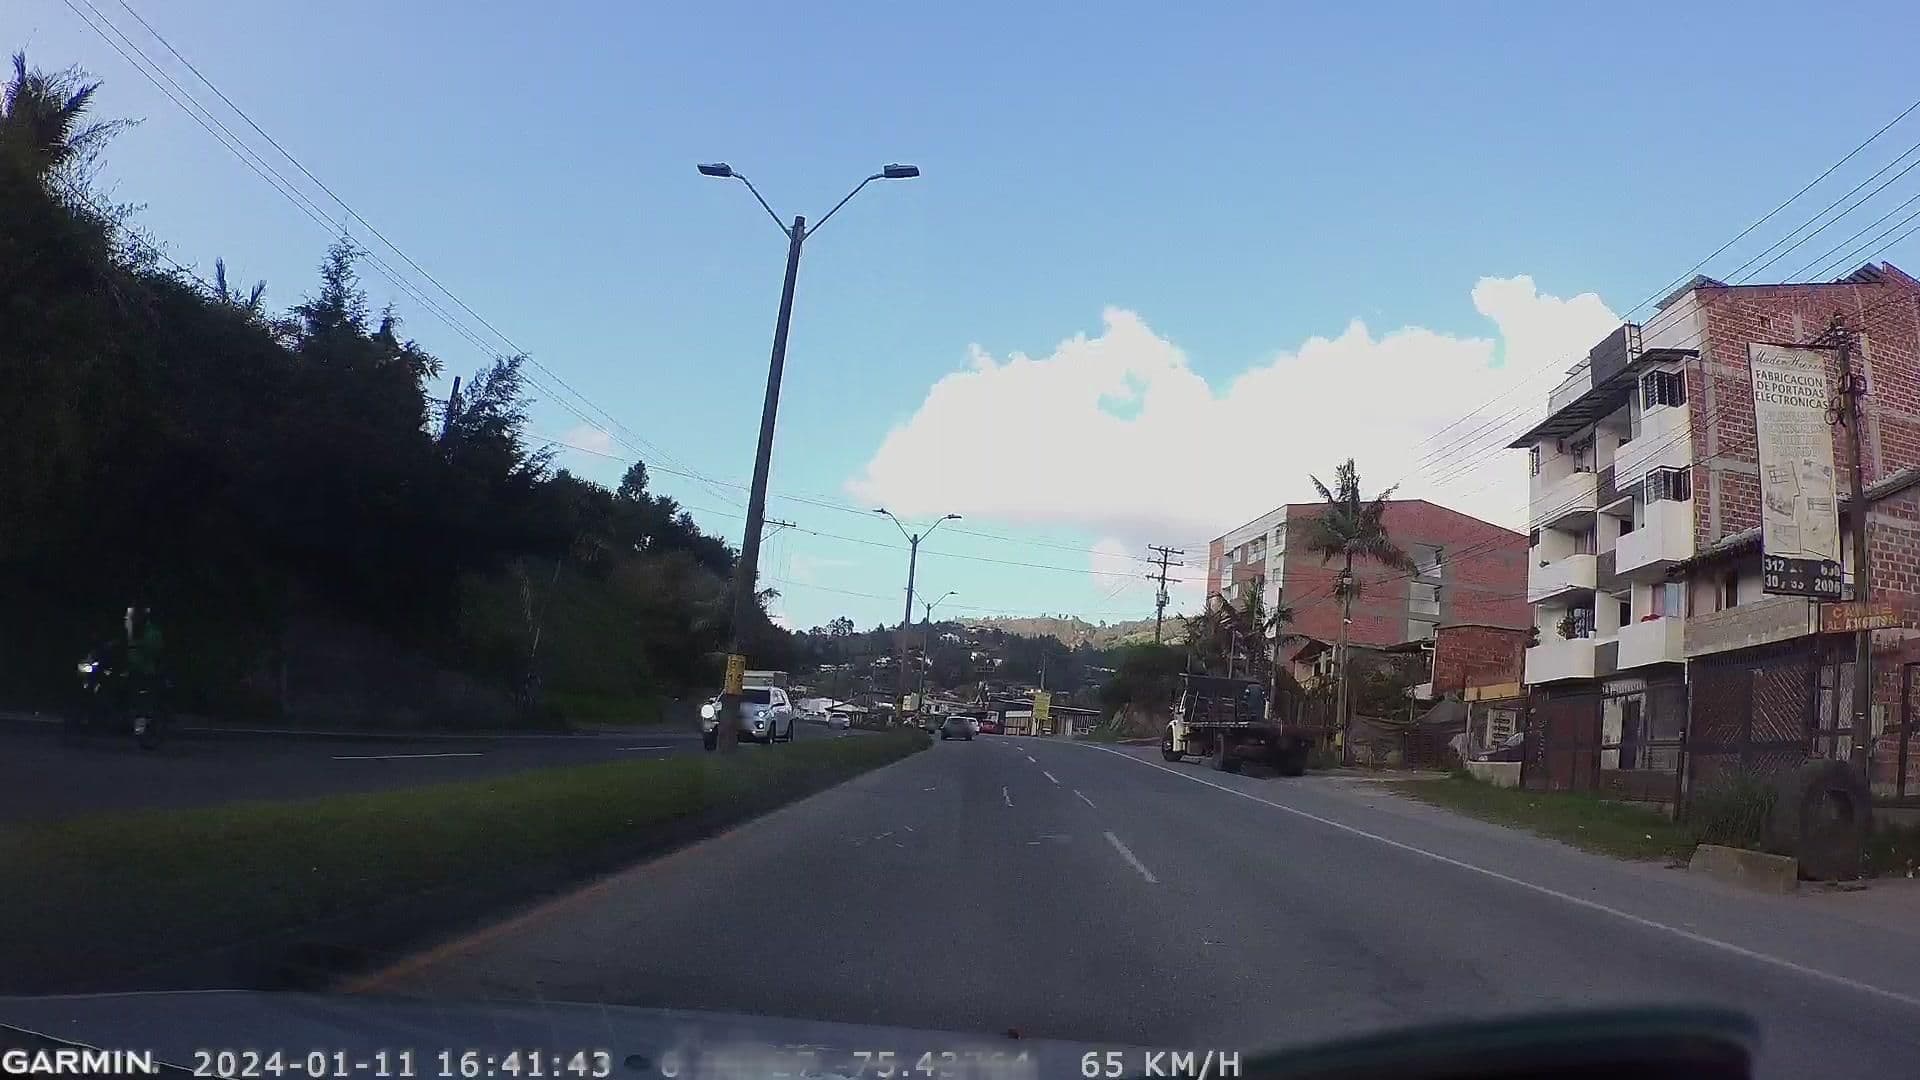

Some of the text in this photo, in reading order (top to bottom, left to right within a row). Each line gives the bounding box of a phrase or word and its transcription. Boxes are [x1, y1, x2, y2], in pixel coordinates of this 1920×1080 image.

[1756, 369, 1823, 388] FABRICACION
[1757, 381, 1824, 399] DE PORTADAS
[1755, 391, 1829, 410] ELECTRONICAS
